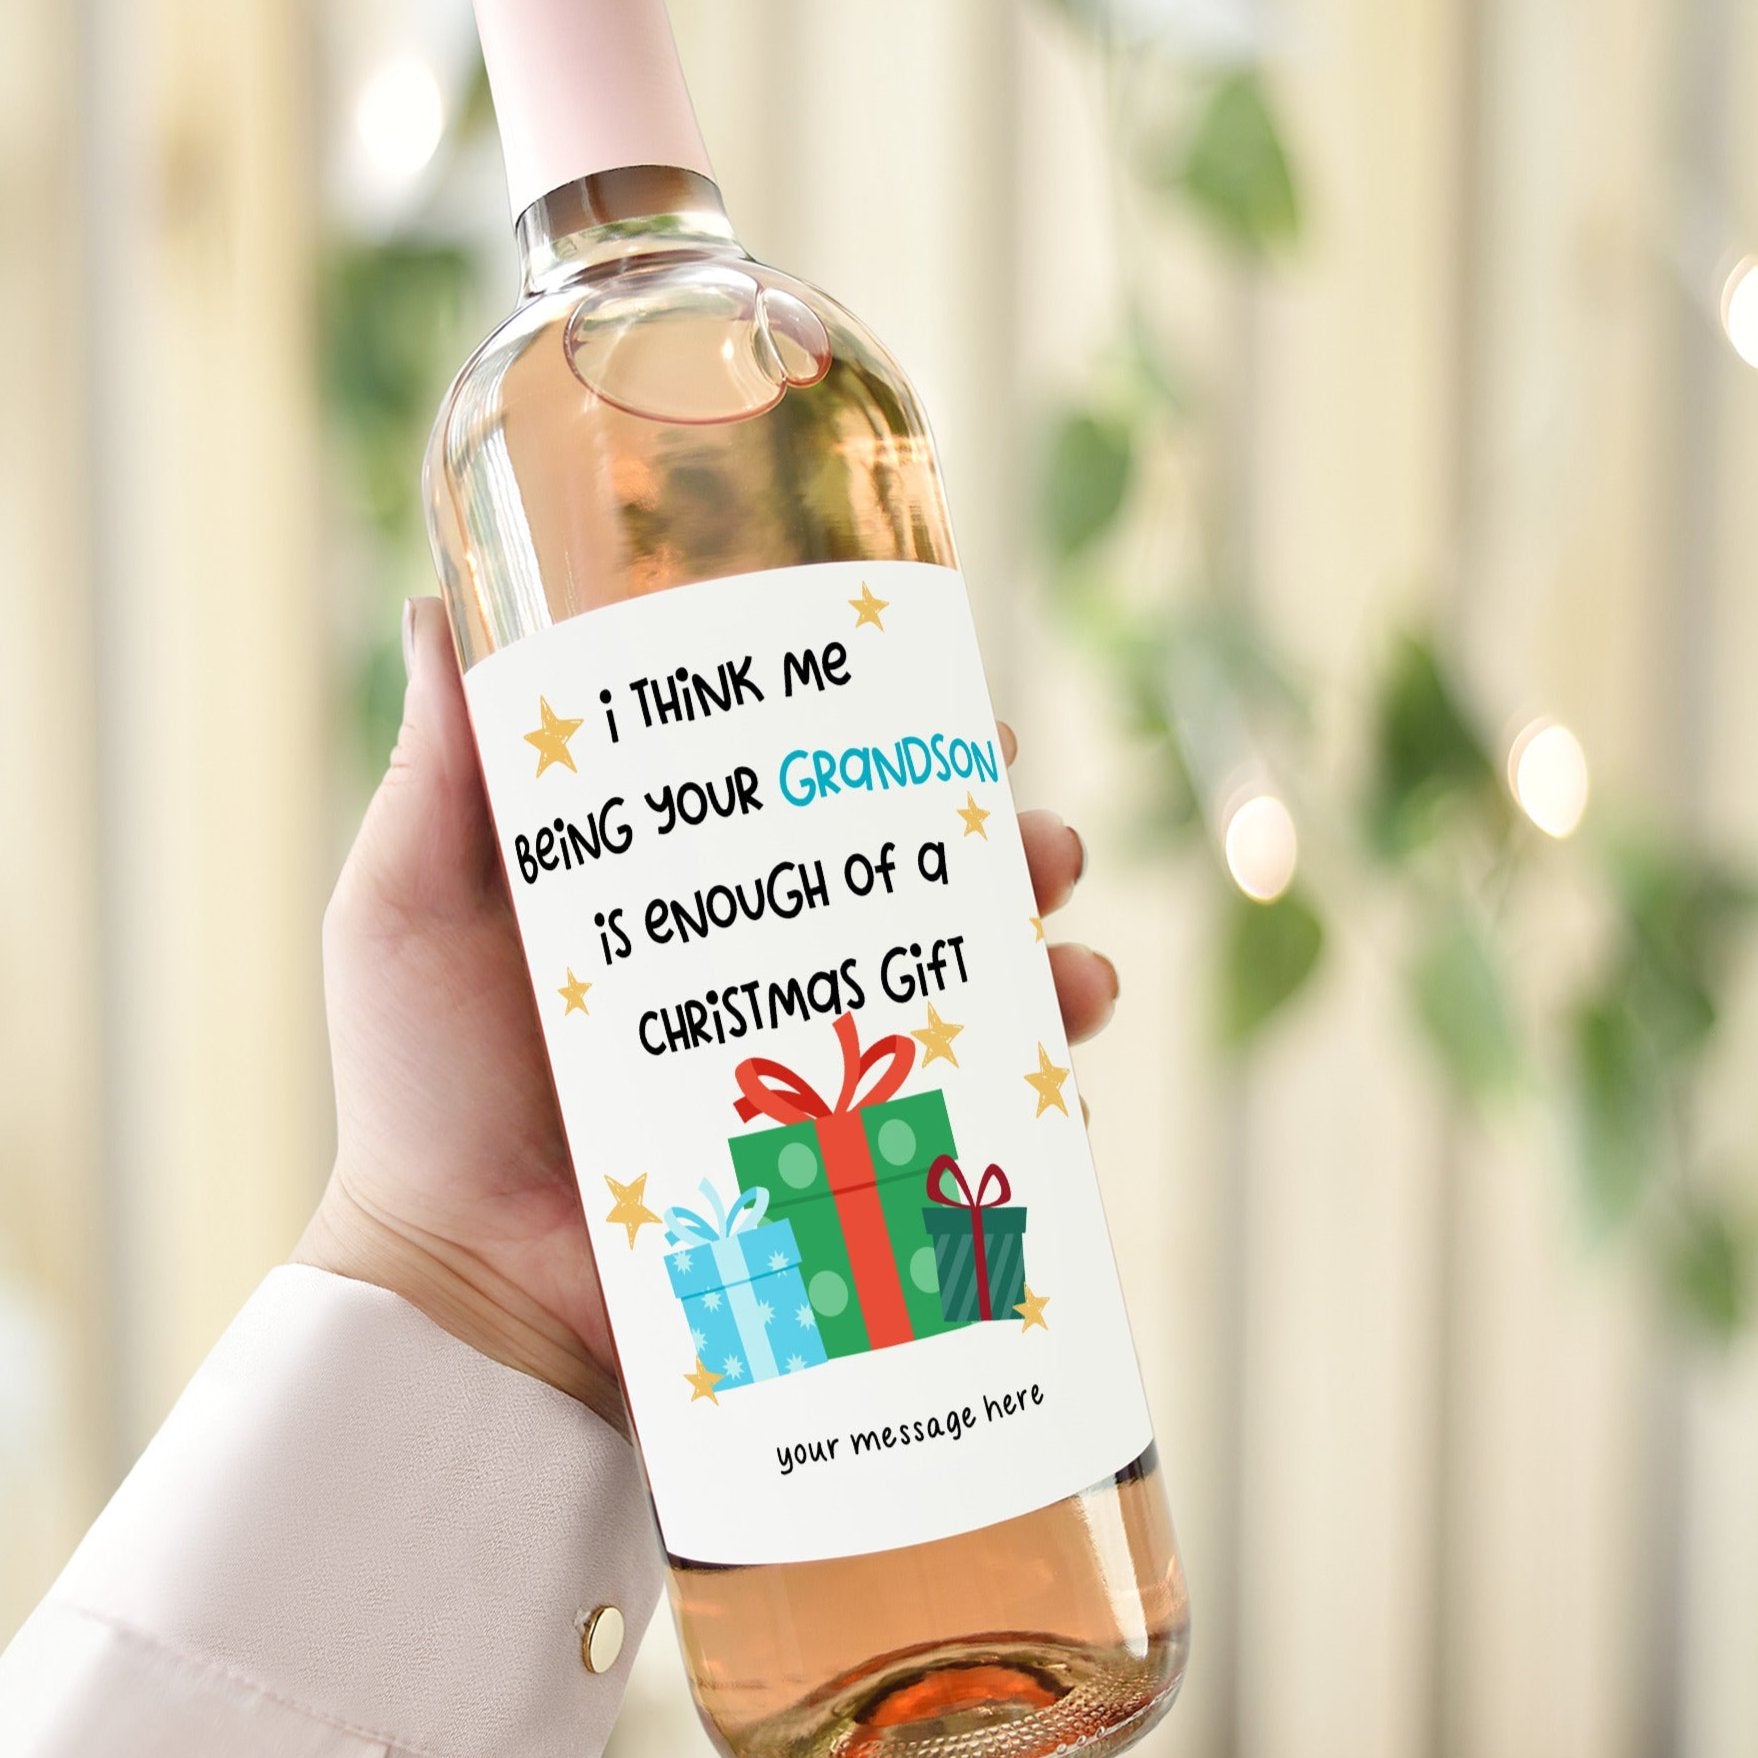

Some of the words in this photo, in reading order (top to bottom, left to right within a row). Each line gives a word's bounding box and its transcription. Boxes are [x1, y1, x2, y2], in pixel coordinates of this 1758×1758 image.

[598, 688, 620, 745] i
[775, 1435, 840, 1477] your
[849, 1405, 978, 1456] message
[981, 1381, 1045, 1423] here
